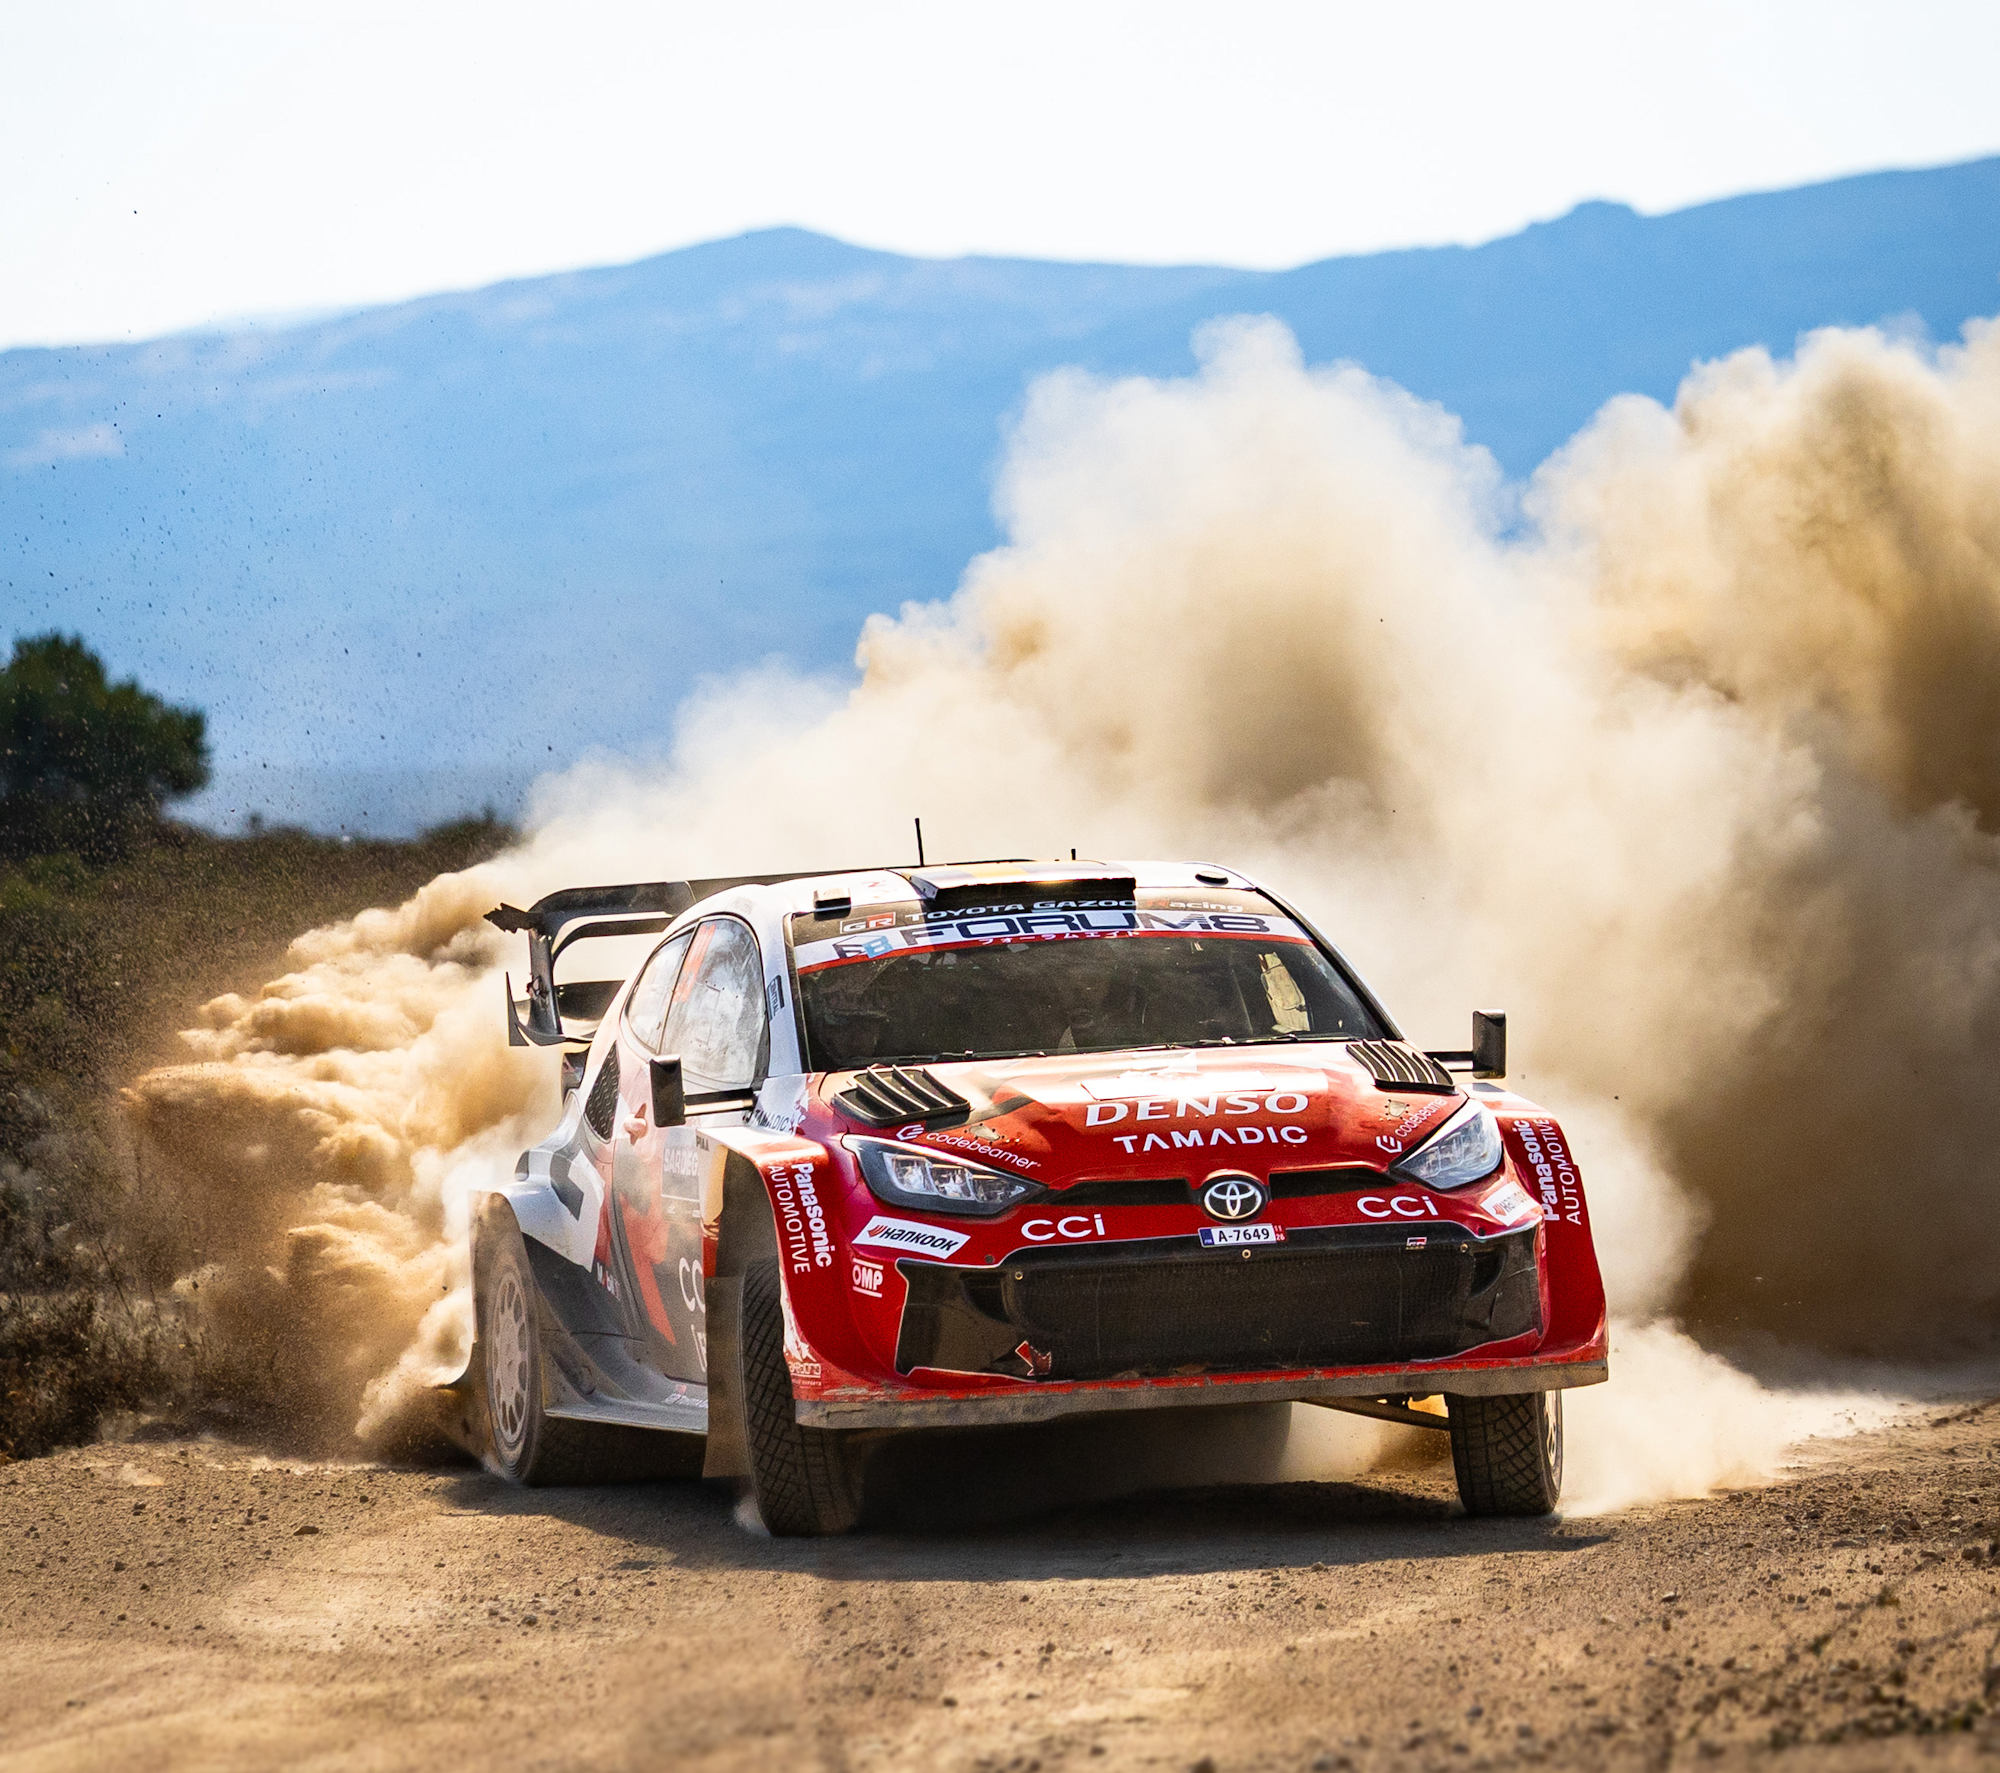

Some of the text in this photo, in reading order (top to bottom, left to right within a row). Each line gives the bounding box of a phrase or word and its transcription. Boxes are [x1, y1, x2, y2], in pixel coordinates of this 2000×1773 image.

[842, 916, 893, 933] GR
[905, 903, 1025, 922] TOYOTA
[1033, 899, 1137, 910] GAZOO
[899, 912, 1270, 946] FORUM8
[1085, 1093, 1309, 1127] DENSO
[926, 1131, 1038, 1170] codebeamer
[1113, 1125, 1309, 1154] TAMADIC
[1512, 1119, 1560, 1222] Panasonic
[1532, 1118, 1582, 1226] AUTOMOTIVE
[768, 1164, 811, 1275] AUTOMOTIVE
[791, 1162, 836, 1268] Panasonic
[1218, 1227, 1270, 1243] A-7649
[852, 1264, 884, 1291] OMP
